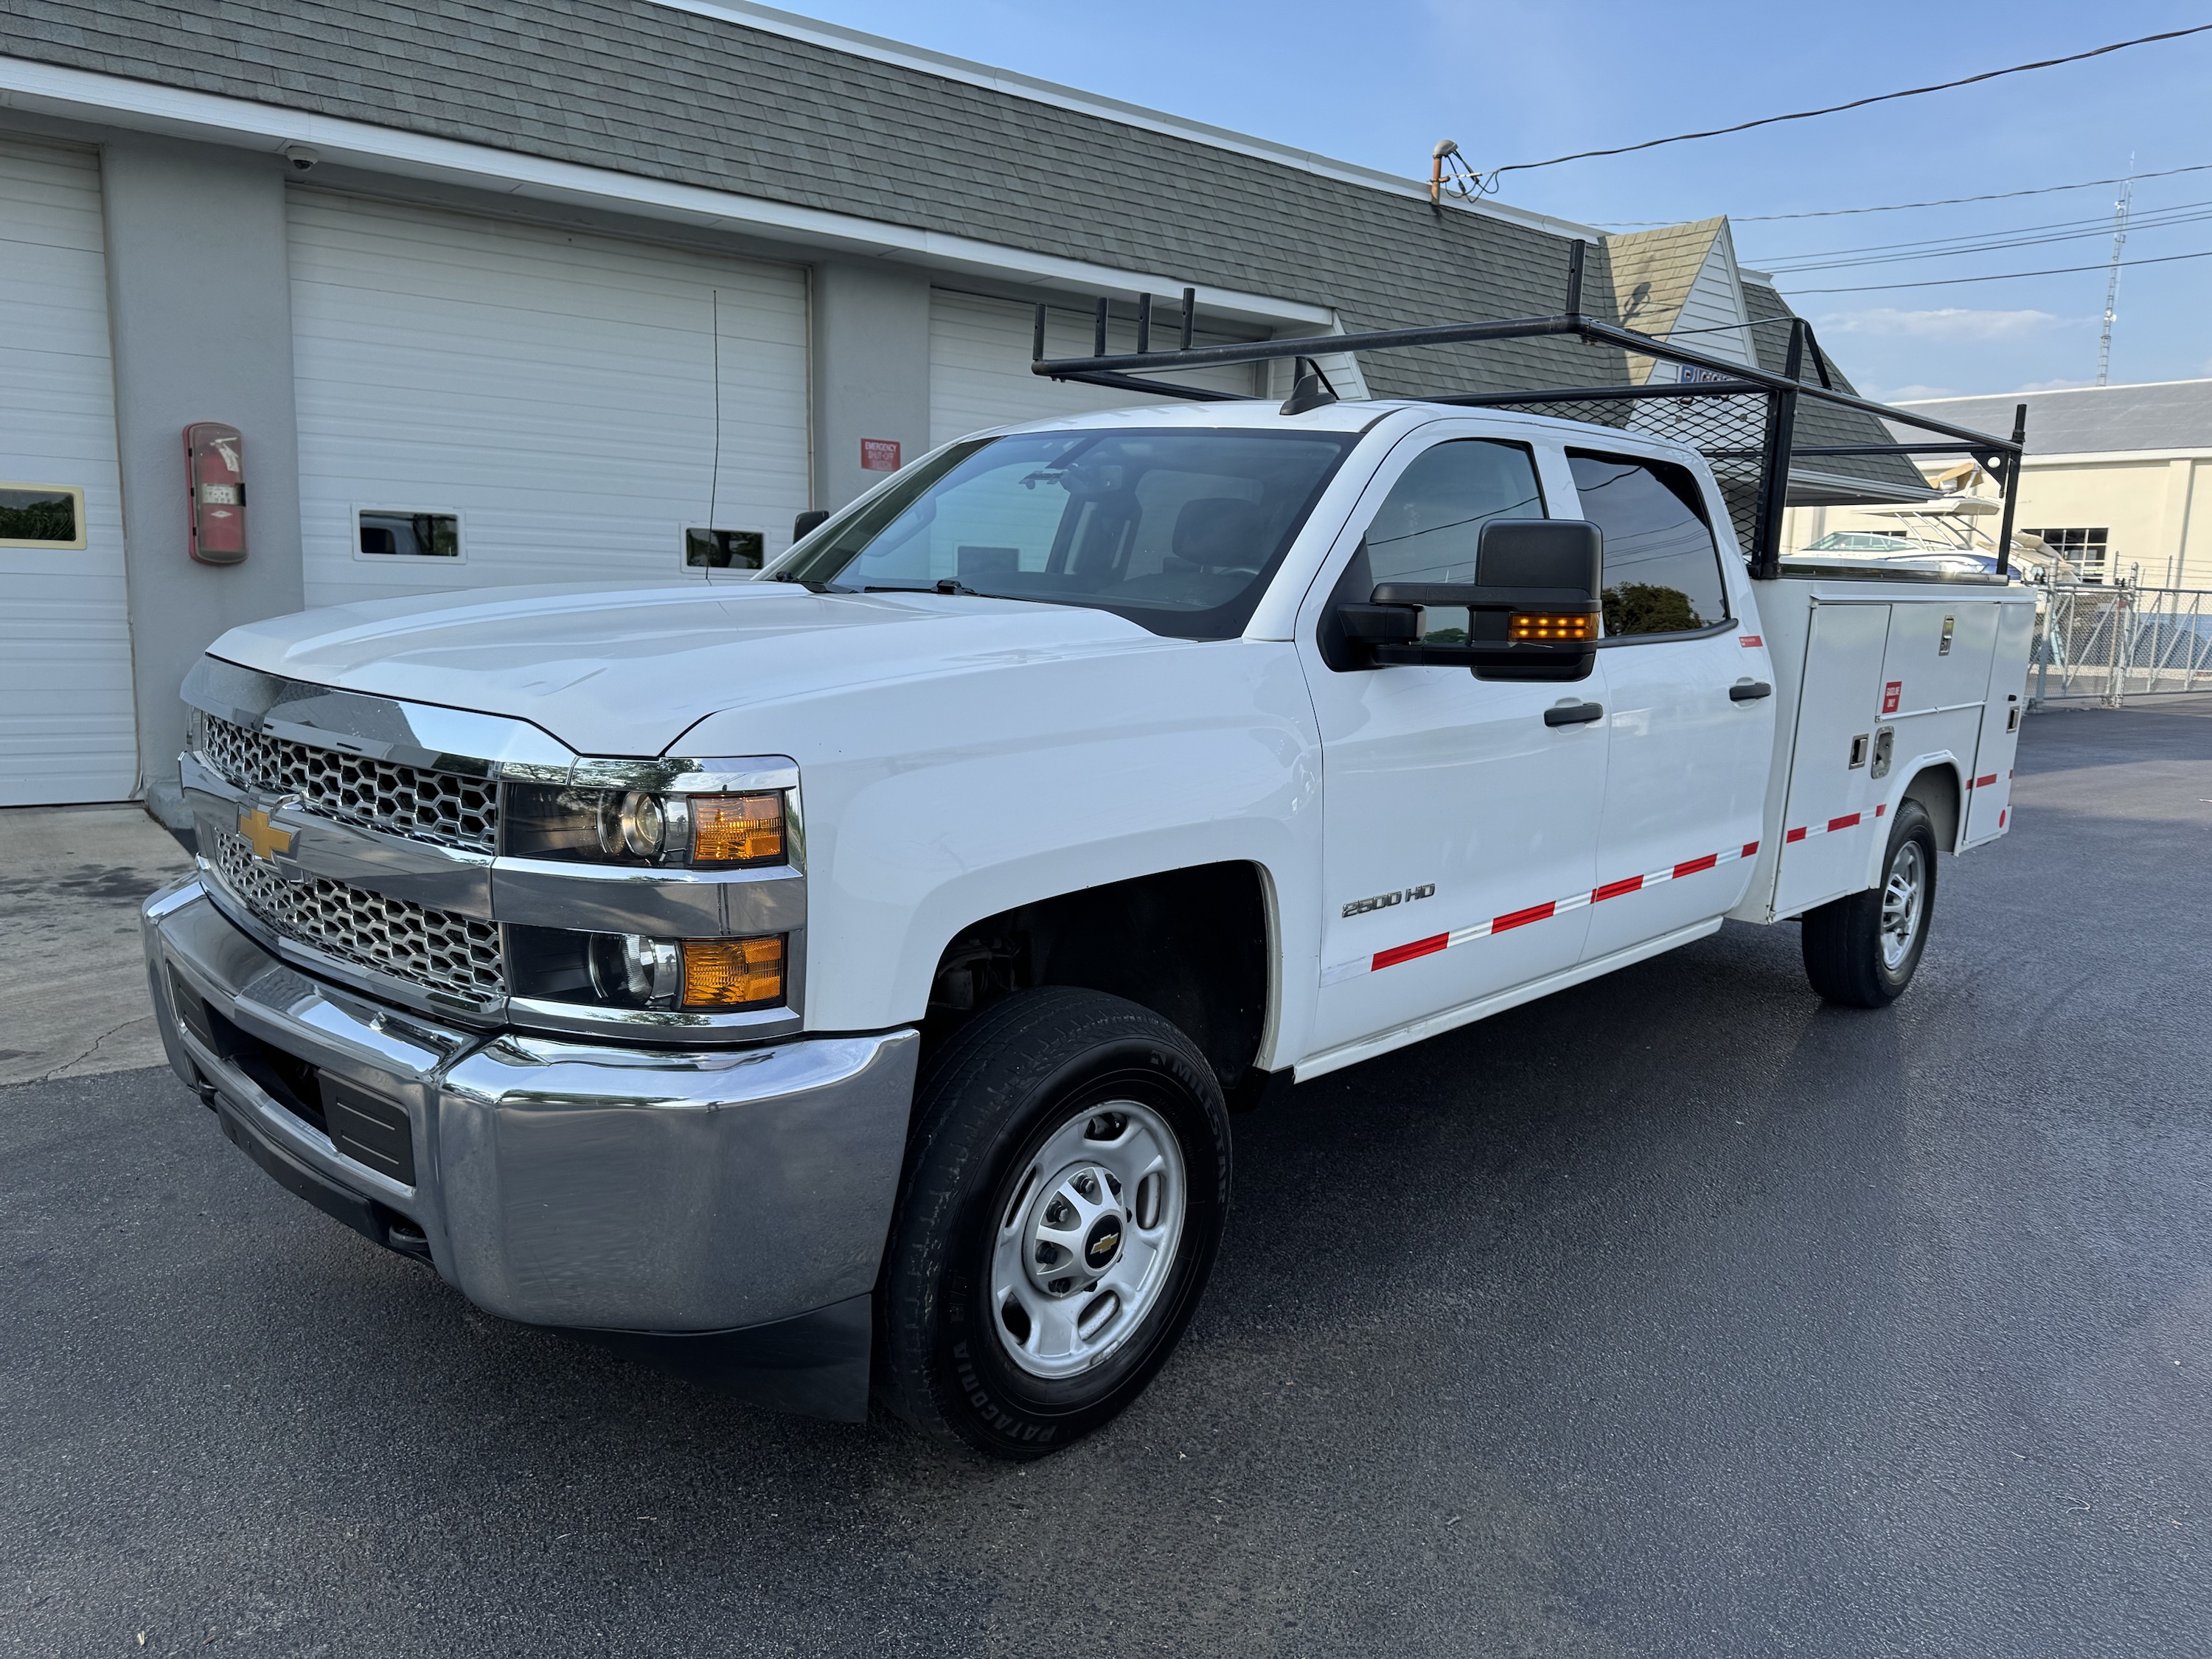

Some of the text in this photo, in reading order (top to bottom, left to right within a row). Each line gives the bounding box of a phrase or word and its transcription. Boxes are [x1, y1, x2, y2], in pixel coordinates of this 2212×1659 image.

[865, 442, 897, 453] EMERGENCY
[868, 451, 894, 461] SHUT-OFF
[1342, 883, 1436, 919] 2500 HD
[1172, 1057, 1227, 1205] MILESTAR
[953, 1339, 1059, 1442] PATAGONIA
